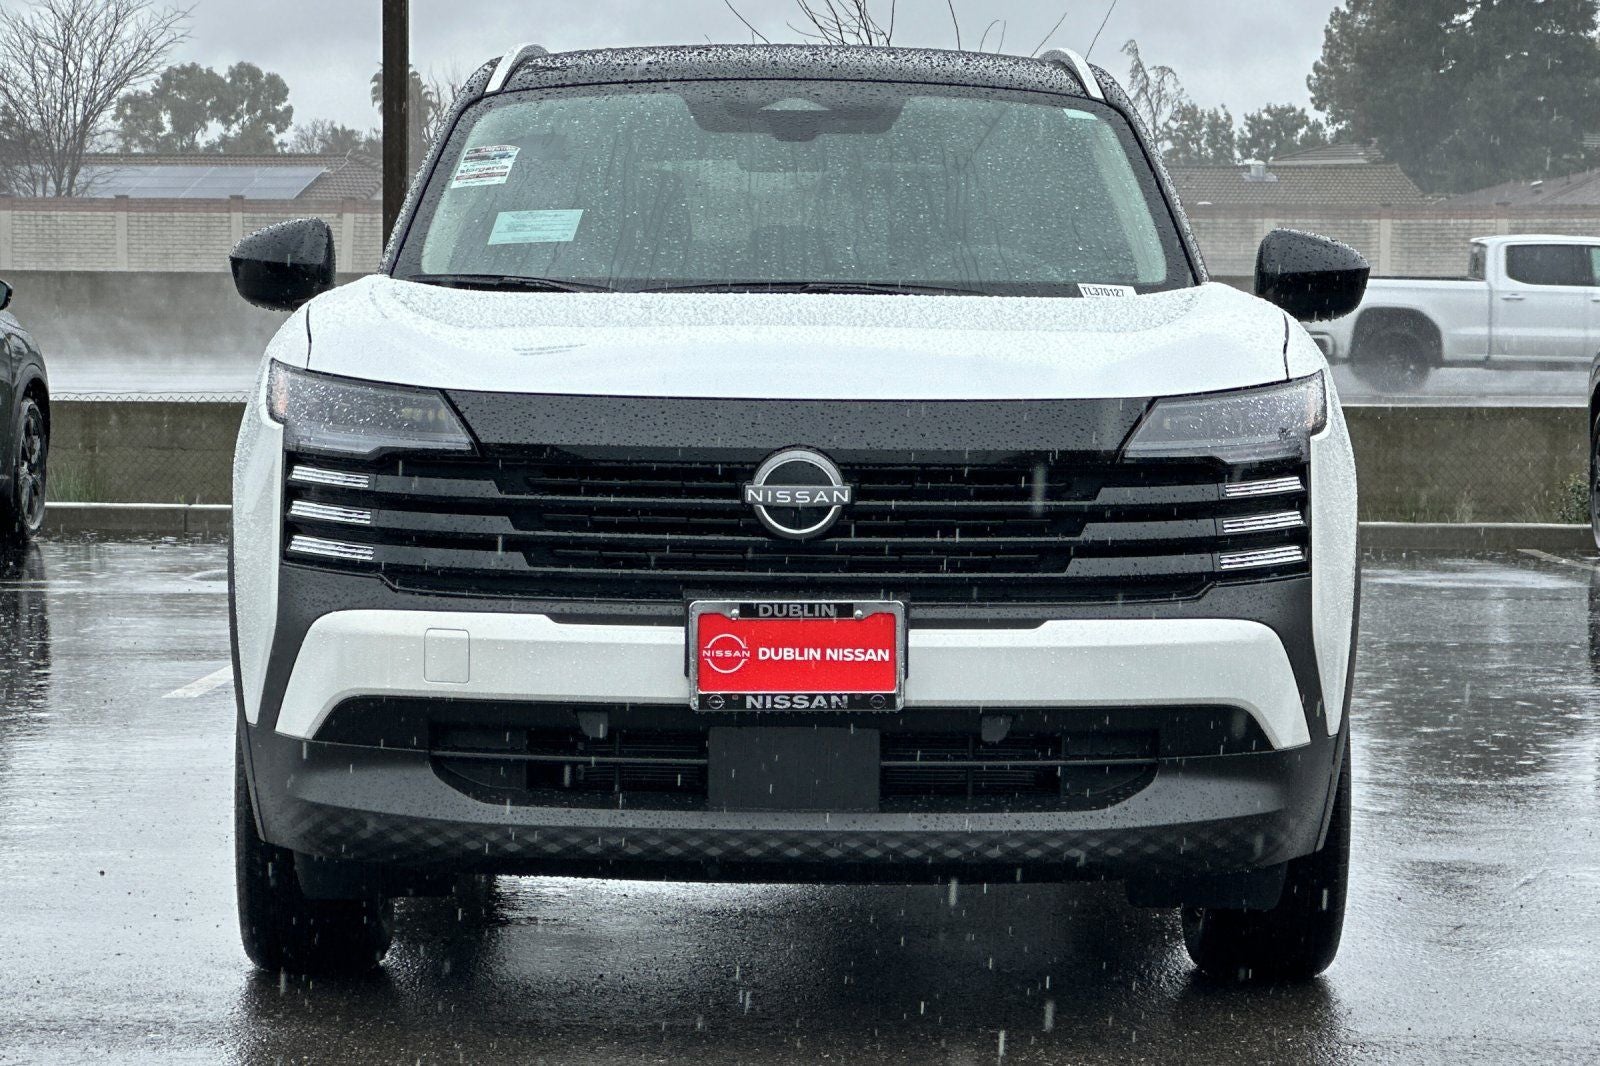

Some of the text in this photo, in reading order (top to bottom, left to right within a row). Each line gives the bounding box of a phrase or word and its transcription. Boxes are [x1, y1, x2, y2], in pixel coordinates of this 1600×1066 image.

[747, 489, 849, 503] NISSAN
[758, 603, 835, 617] DUBLIN
[702, 649, 750, 658] NISSAN
[758, 647, 890, 662] DUBLIN NISSAN
[745, 695, 849, 709] NISSAN
